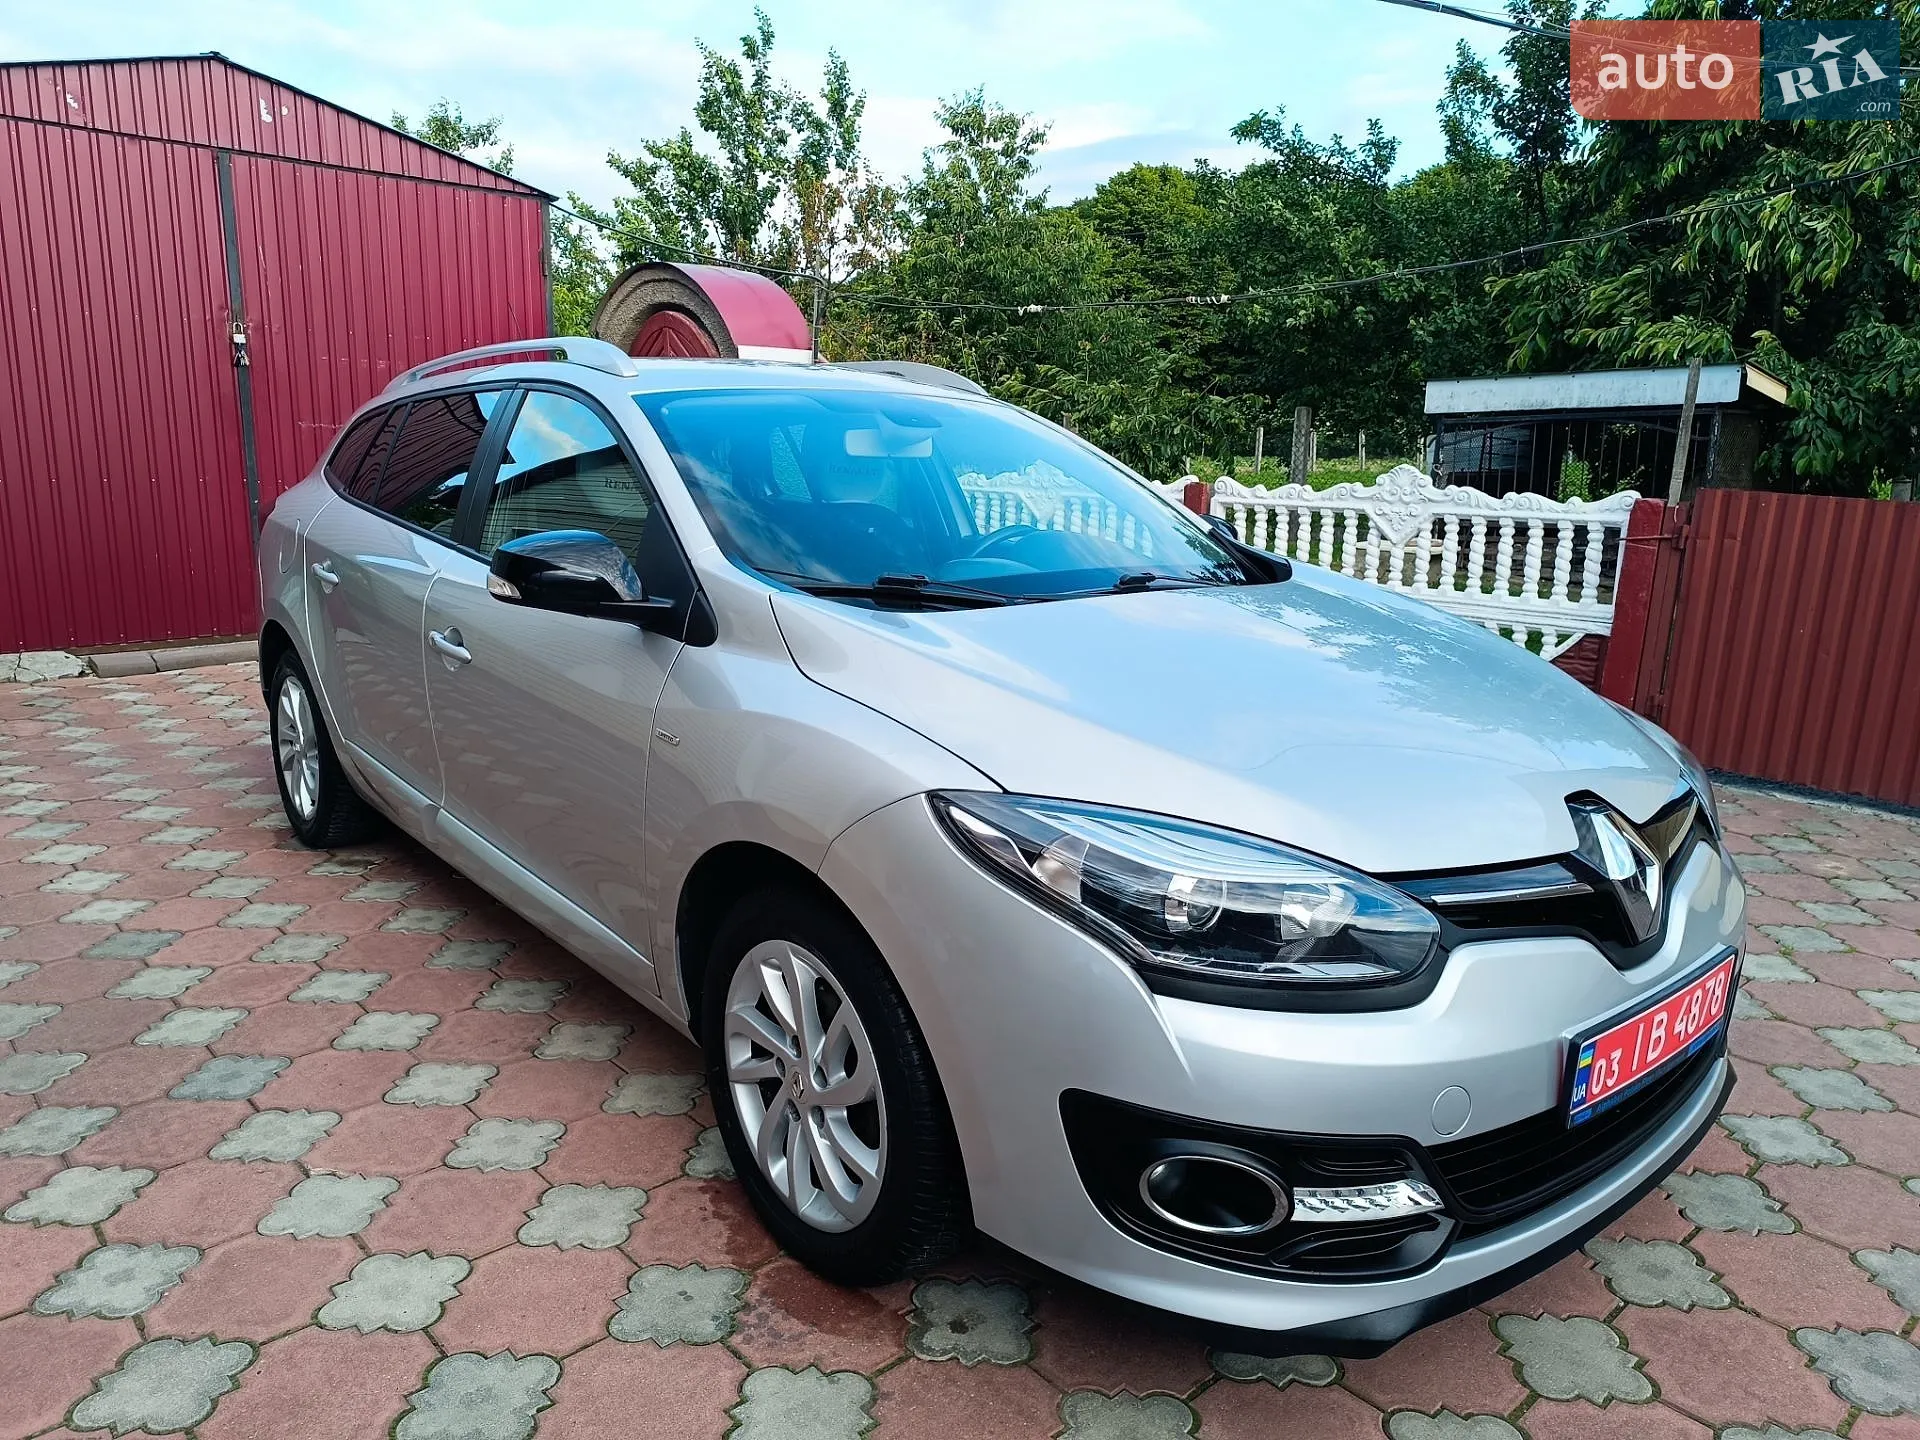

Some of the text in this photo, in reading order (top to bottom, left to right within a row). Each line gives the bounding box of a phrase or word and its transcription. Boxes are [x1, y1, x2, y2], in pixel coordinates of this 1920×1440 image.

[1591, 1048, 1623, 1095] 03
[1632, 1010, 1669, 1072] IB
[1673, 971, 1725, 1042] 4878
[1573, 1083, 1586, 1102] UA
